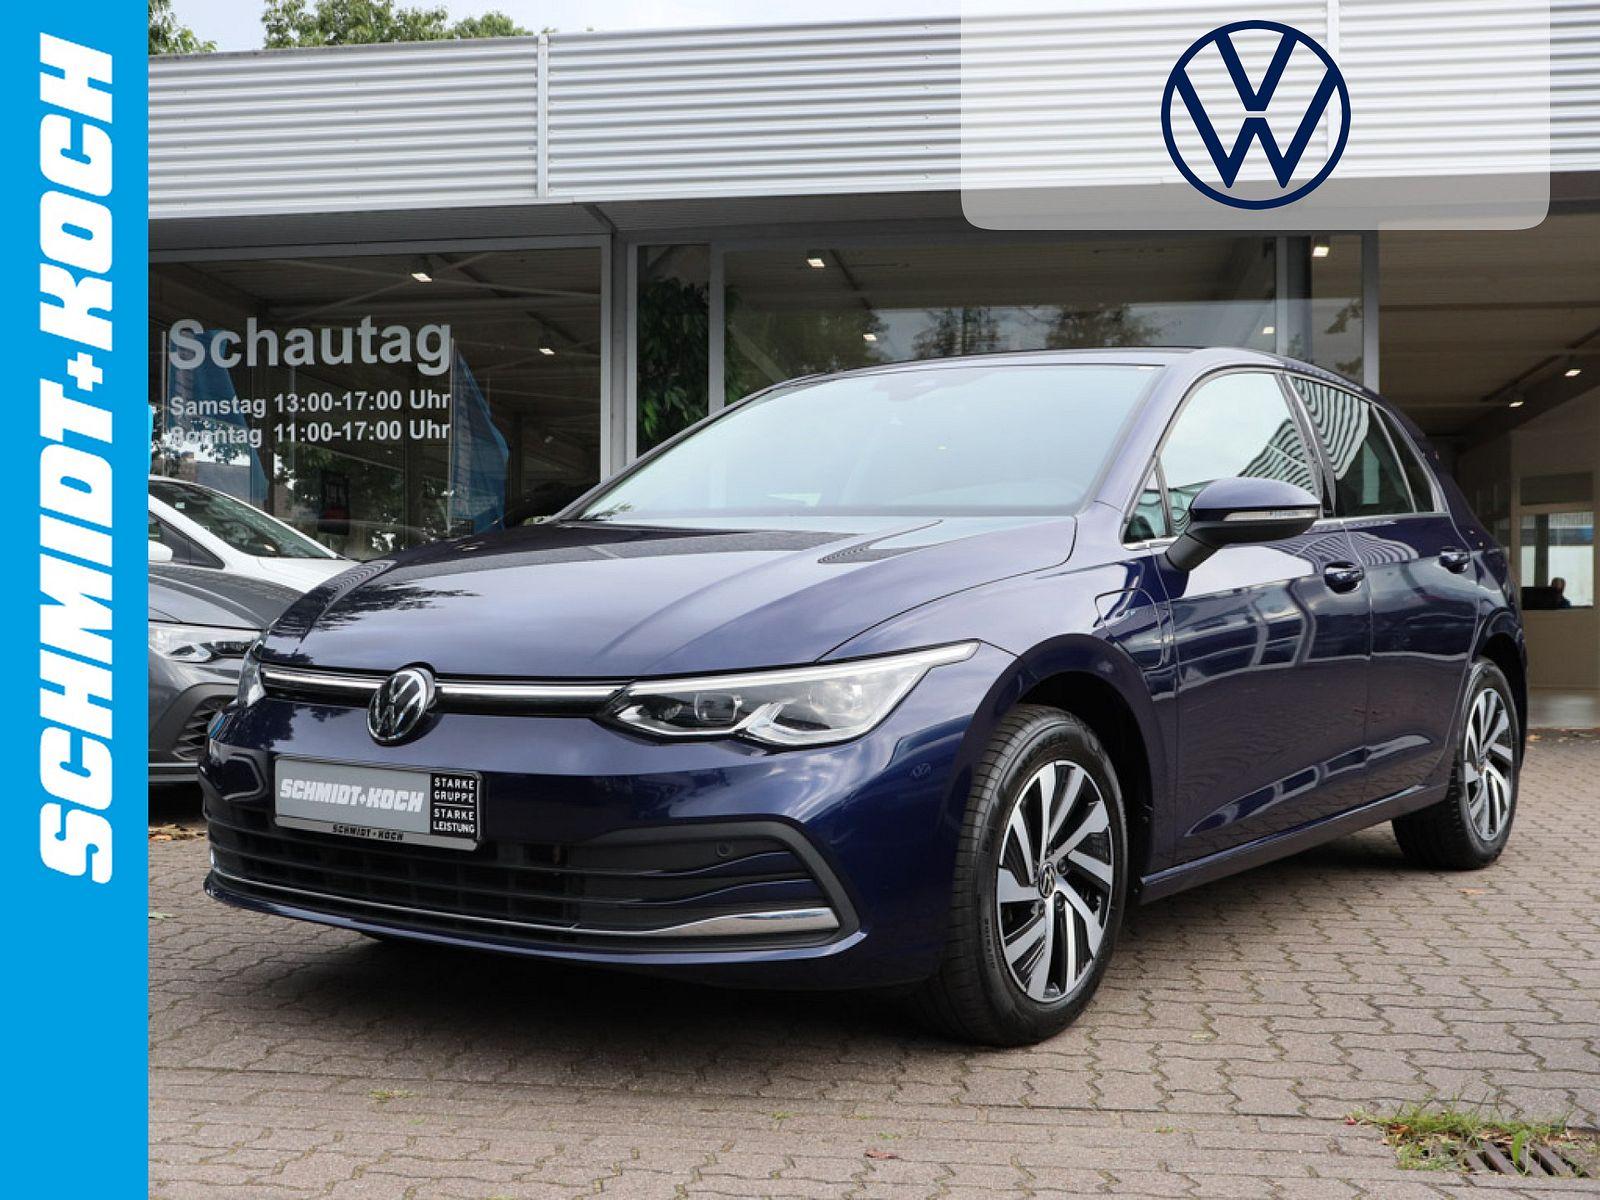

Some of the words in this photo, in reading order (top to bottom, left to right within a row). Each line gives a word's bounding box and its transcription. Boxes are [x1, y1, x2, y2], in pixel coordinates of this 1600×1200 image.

[168, 315, 450, 375] Schautag
[169, 395, 267, 419] Samstag
[273, 390, 402, 413] 13:00-17:00
[408, 388, 451, 410] Uhr
[168, 424, 263, 448] Sonntag
[273, 420, 402, 443] 11:00-17:00
[408, 420, 450, 439] Uhr
[434, 777, 475, 790] STARKE
[434, 790, 475, 803] GRUPPE
[434, 808, 475, 821] STARKE
[432, 820, 475, 833] LEISTUNG
